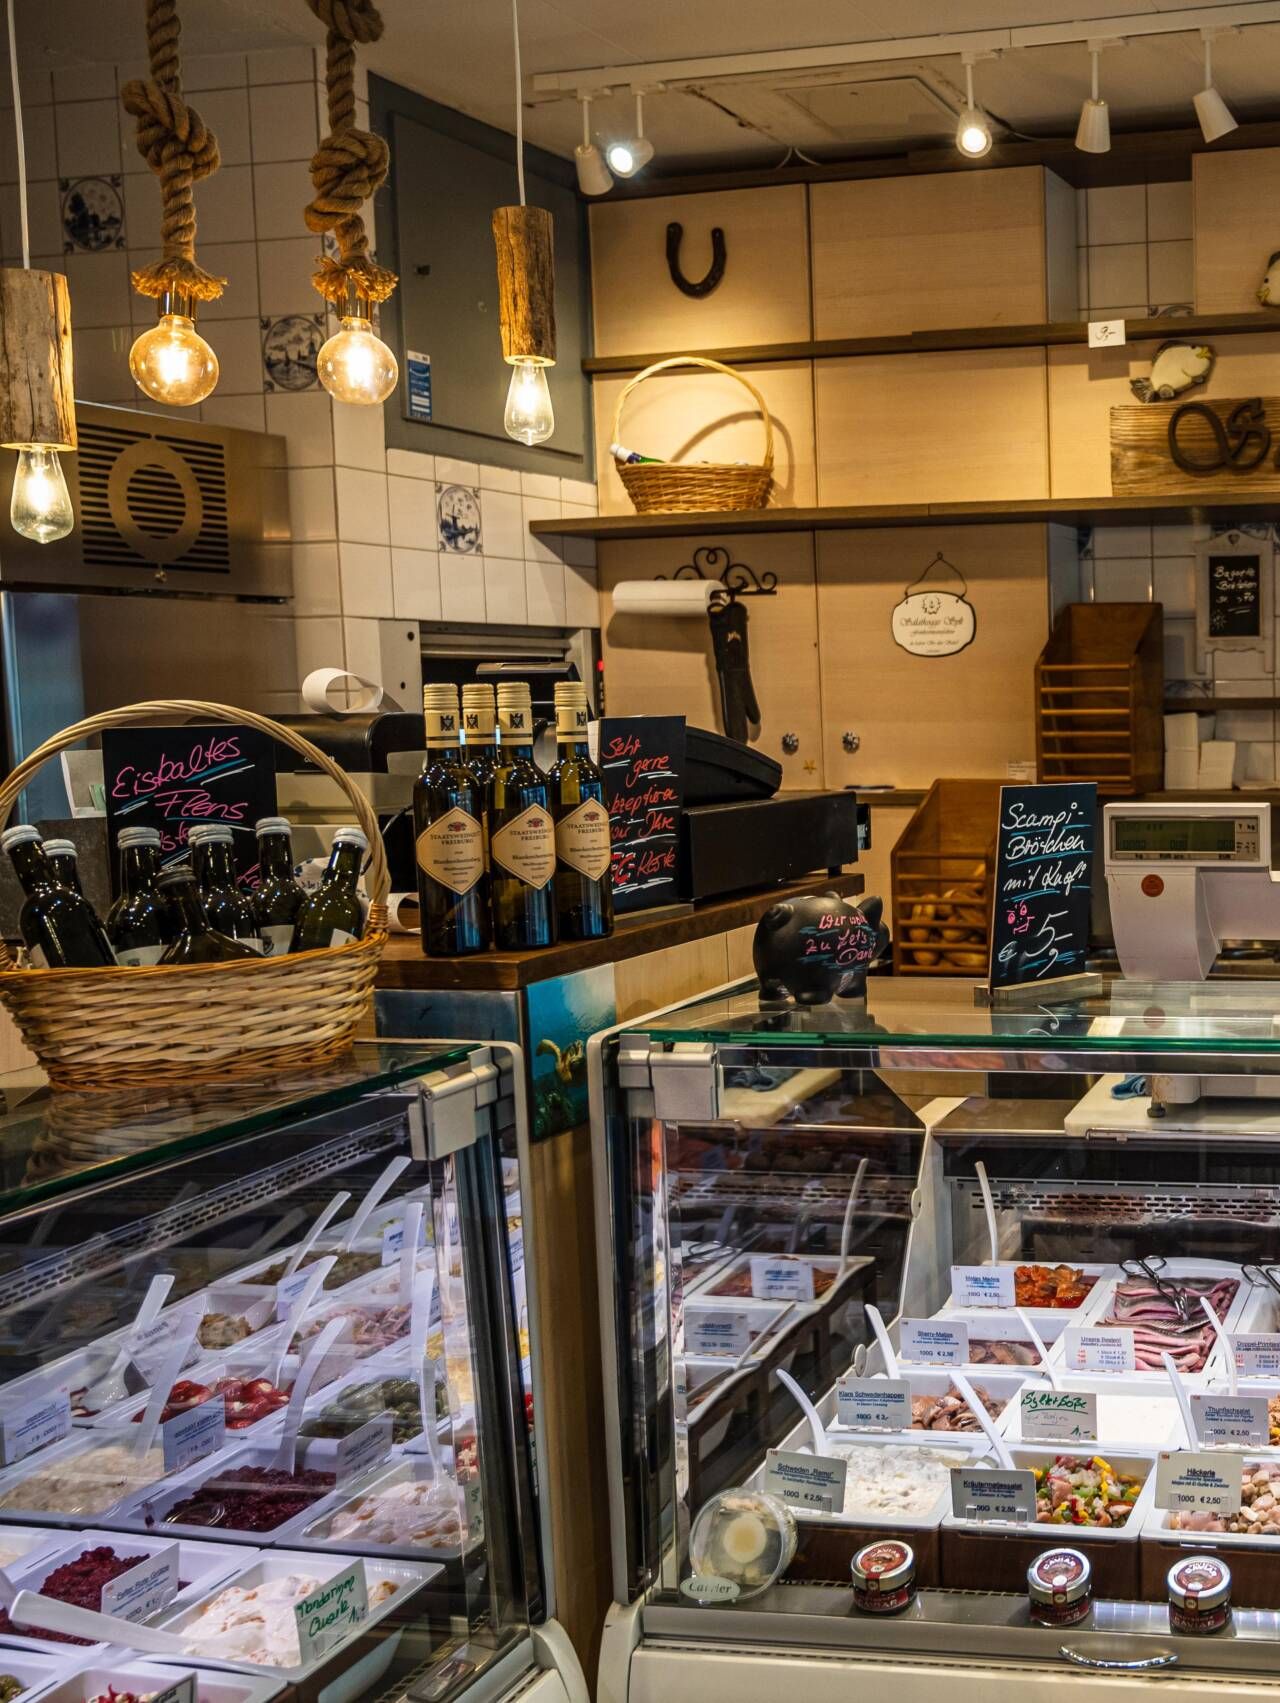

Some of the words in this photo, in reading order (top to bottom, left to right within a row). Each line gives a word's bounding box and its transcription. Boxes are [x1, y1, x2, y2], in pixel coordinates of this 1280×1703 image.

[154, 788, 249, 820] Flens
[1002, 802, 1084, 837] Scampi-
[441, 838, 475, 846] FREIBURG
[1005, 829, 1086, 860] Brötchen
[1003, 865, 1042, 892] mit
[998, 941, 1018, 962] €
[854, 1391, 905, 1399] Schwedenhappen
[1208, 1406, 1251, 1415] Thunfischsalat
[1186, 1468, 1216, 1478] Häckerle
[783, 1489, 800, 1498] 100G
[1177, 1495, 1195, 1503] 100G
[1206, 1497, 1221, 1505] 2,50
[1043, 1557, 1076, 1570] CAVIAR
[1184, 1564, 1218, 1577] CAVIAR
